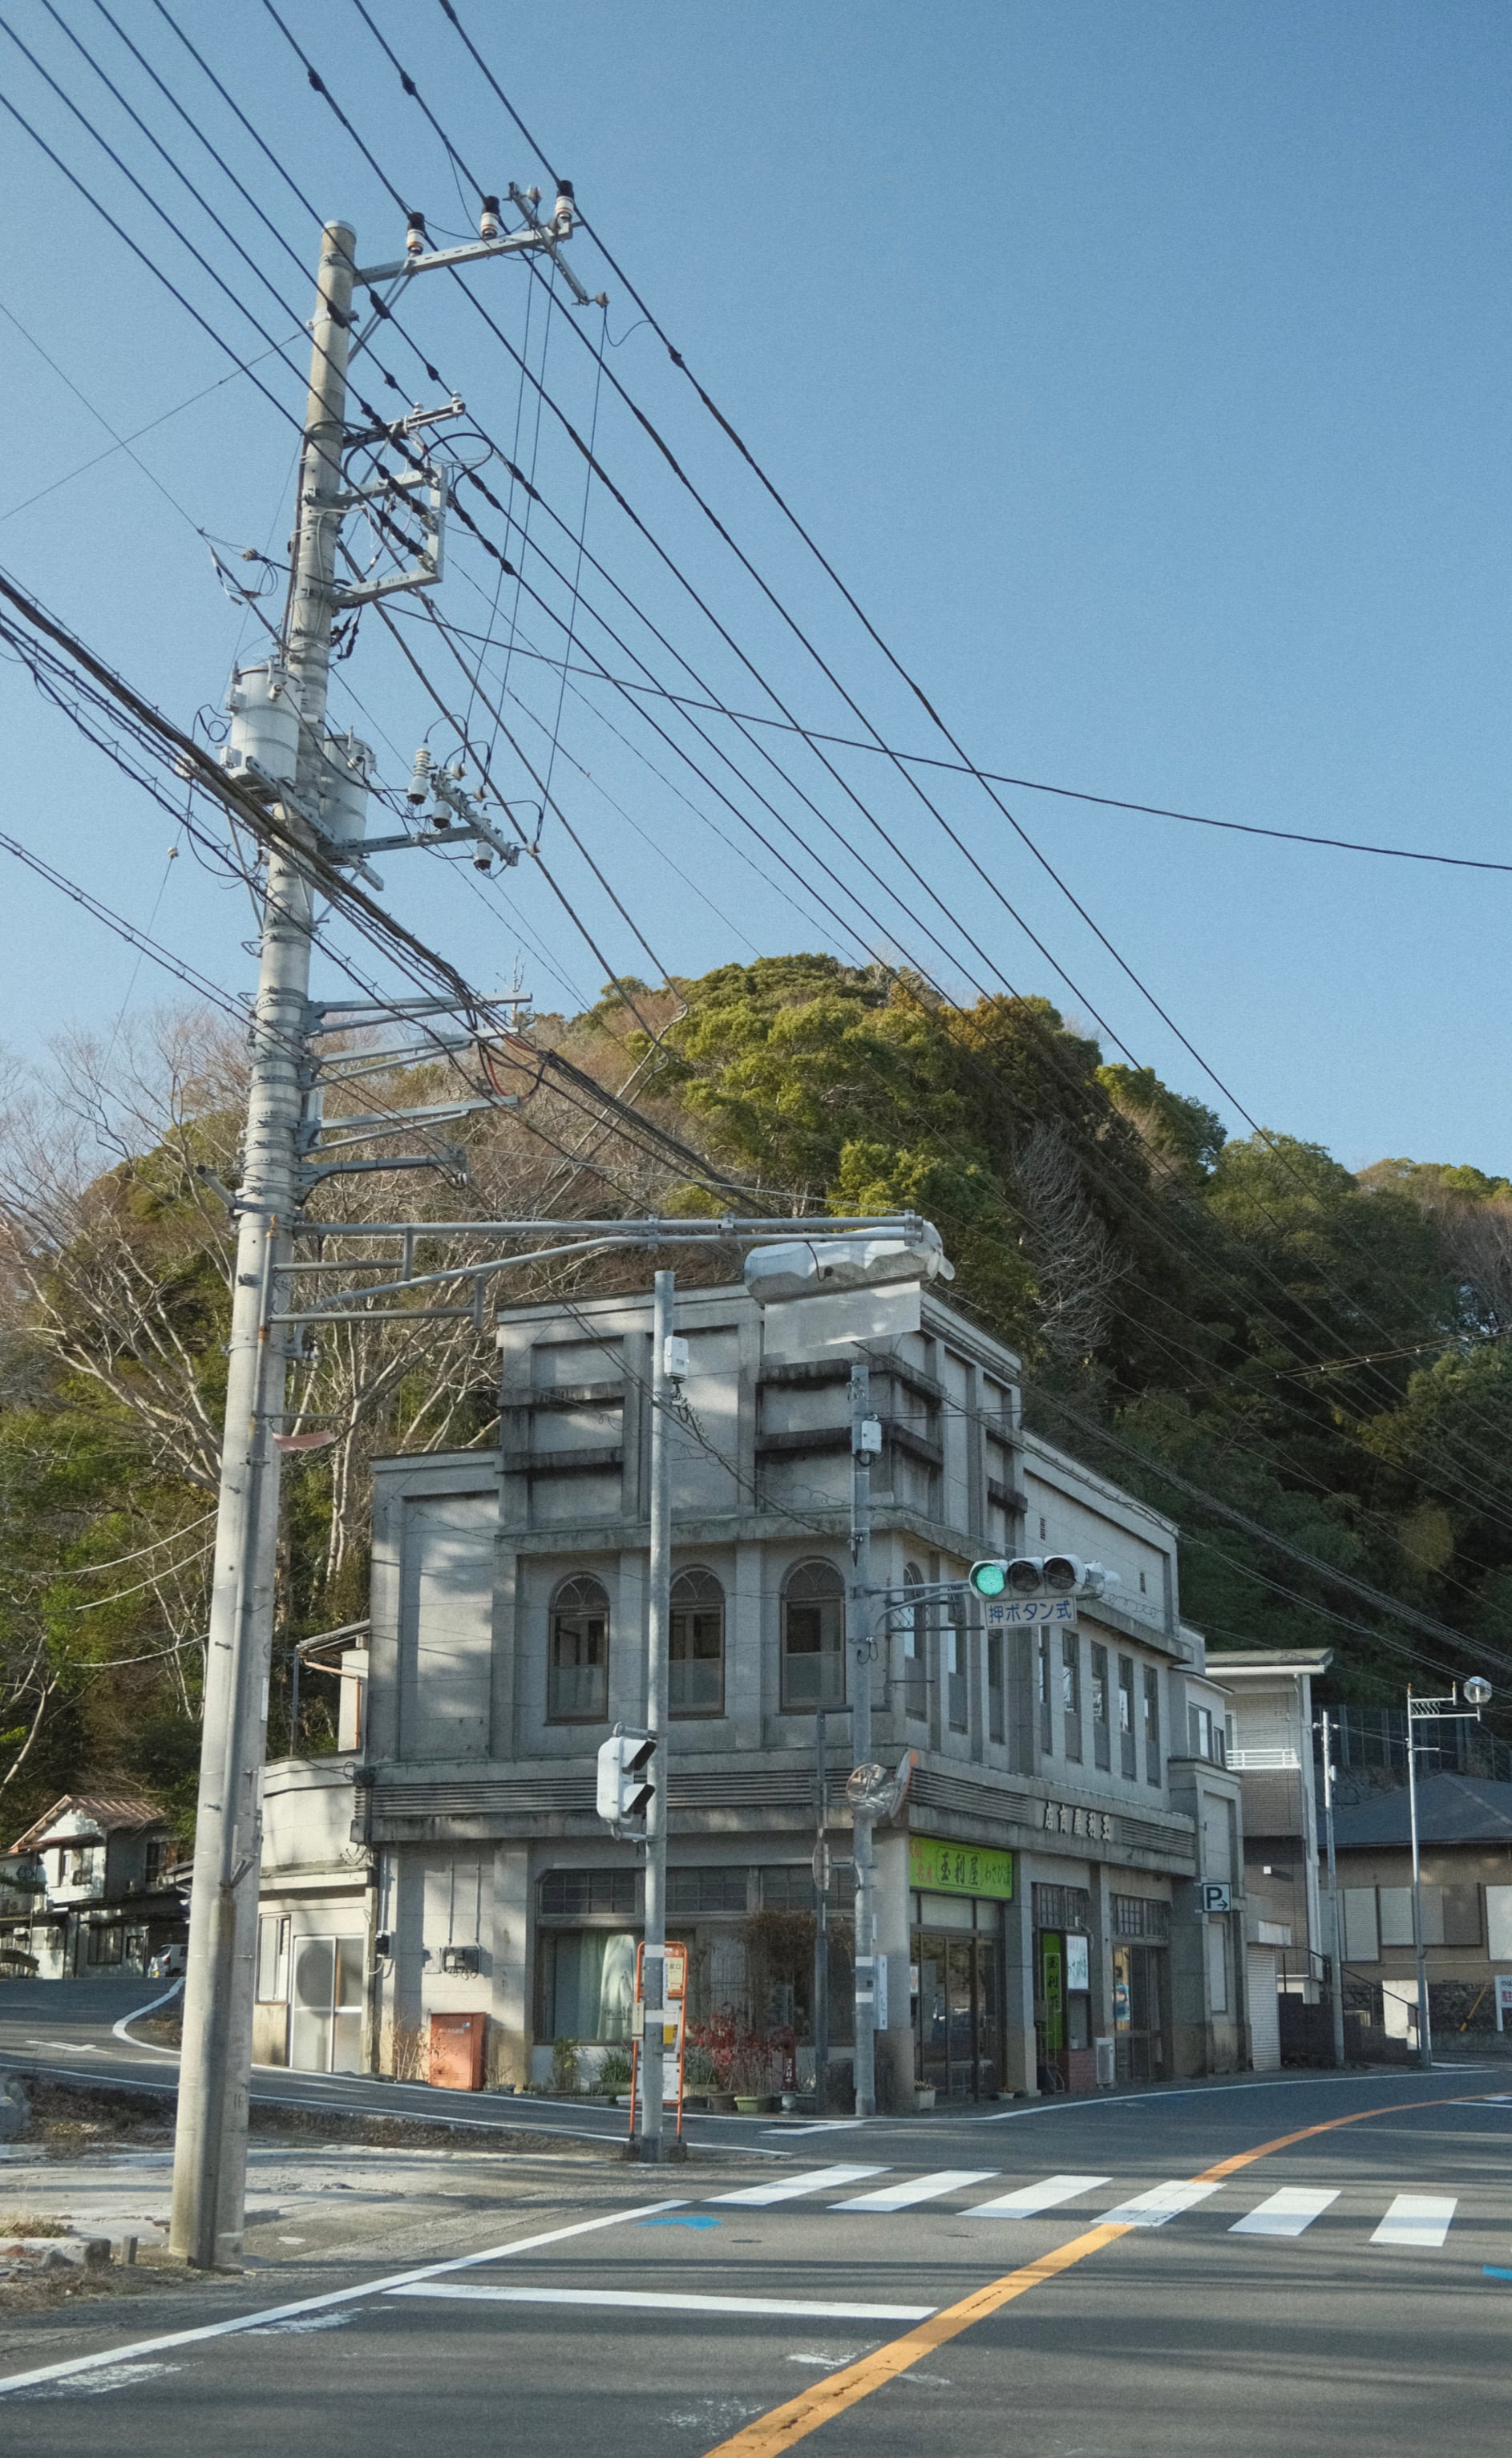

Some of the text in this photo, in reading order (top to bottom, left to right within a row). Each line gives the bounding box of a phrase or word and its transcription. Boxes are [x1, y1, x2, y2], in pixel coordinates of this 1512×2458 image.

[989, 1599, 1072, 1623] 押ボタン式
[1207, 1886, 1223, 1909] P
